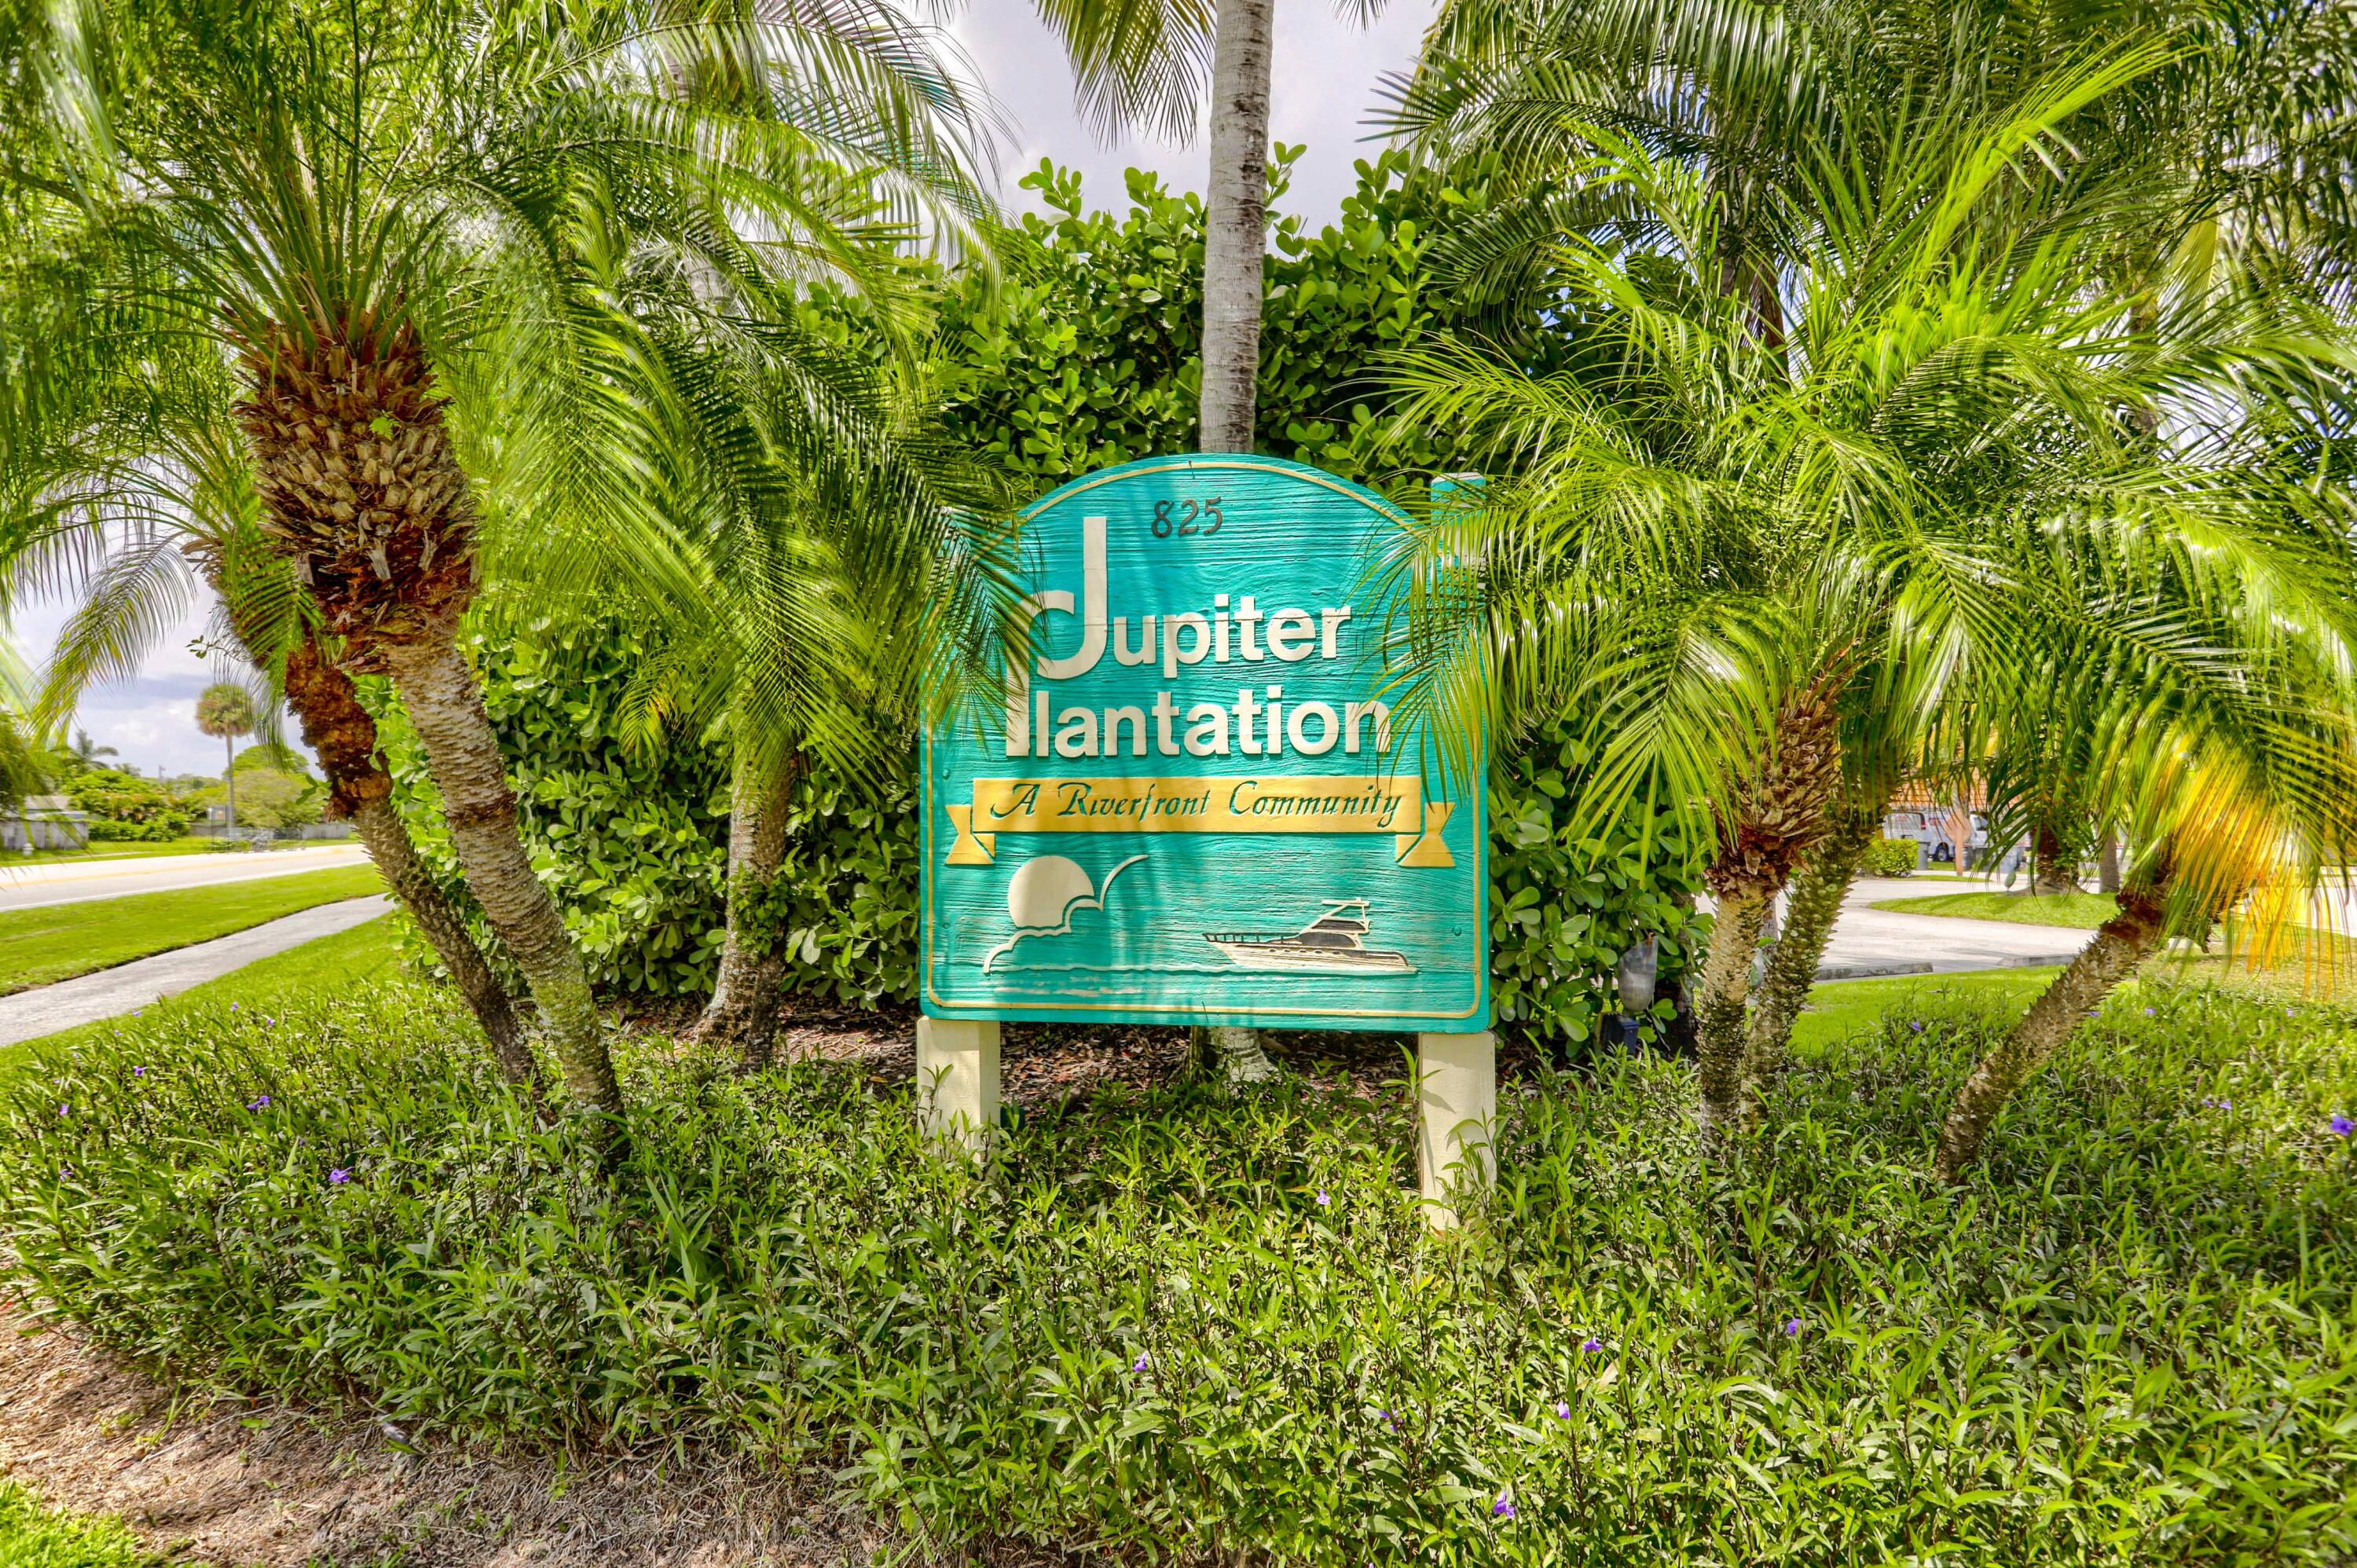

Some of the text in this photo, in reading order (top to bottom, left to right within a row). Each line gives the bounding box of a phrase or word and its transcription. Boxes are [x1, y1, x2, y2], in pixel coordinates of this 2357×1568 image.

[1151, 496, 1223, 538] 825
[1036, 515, 1352, 680] Jupiter
[990, 780, 1402, 829] A Riverfront Community
